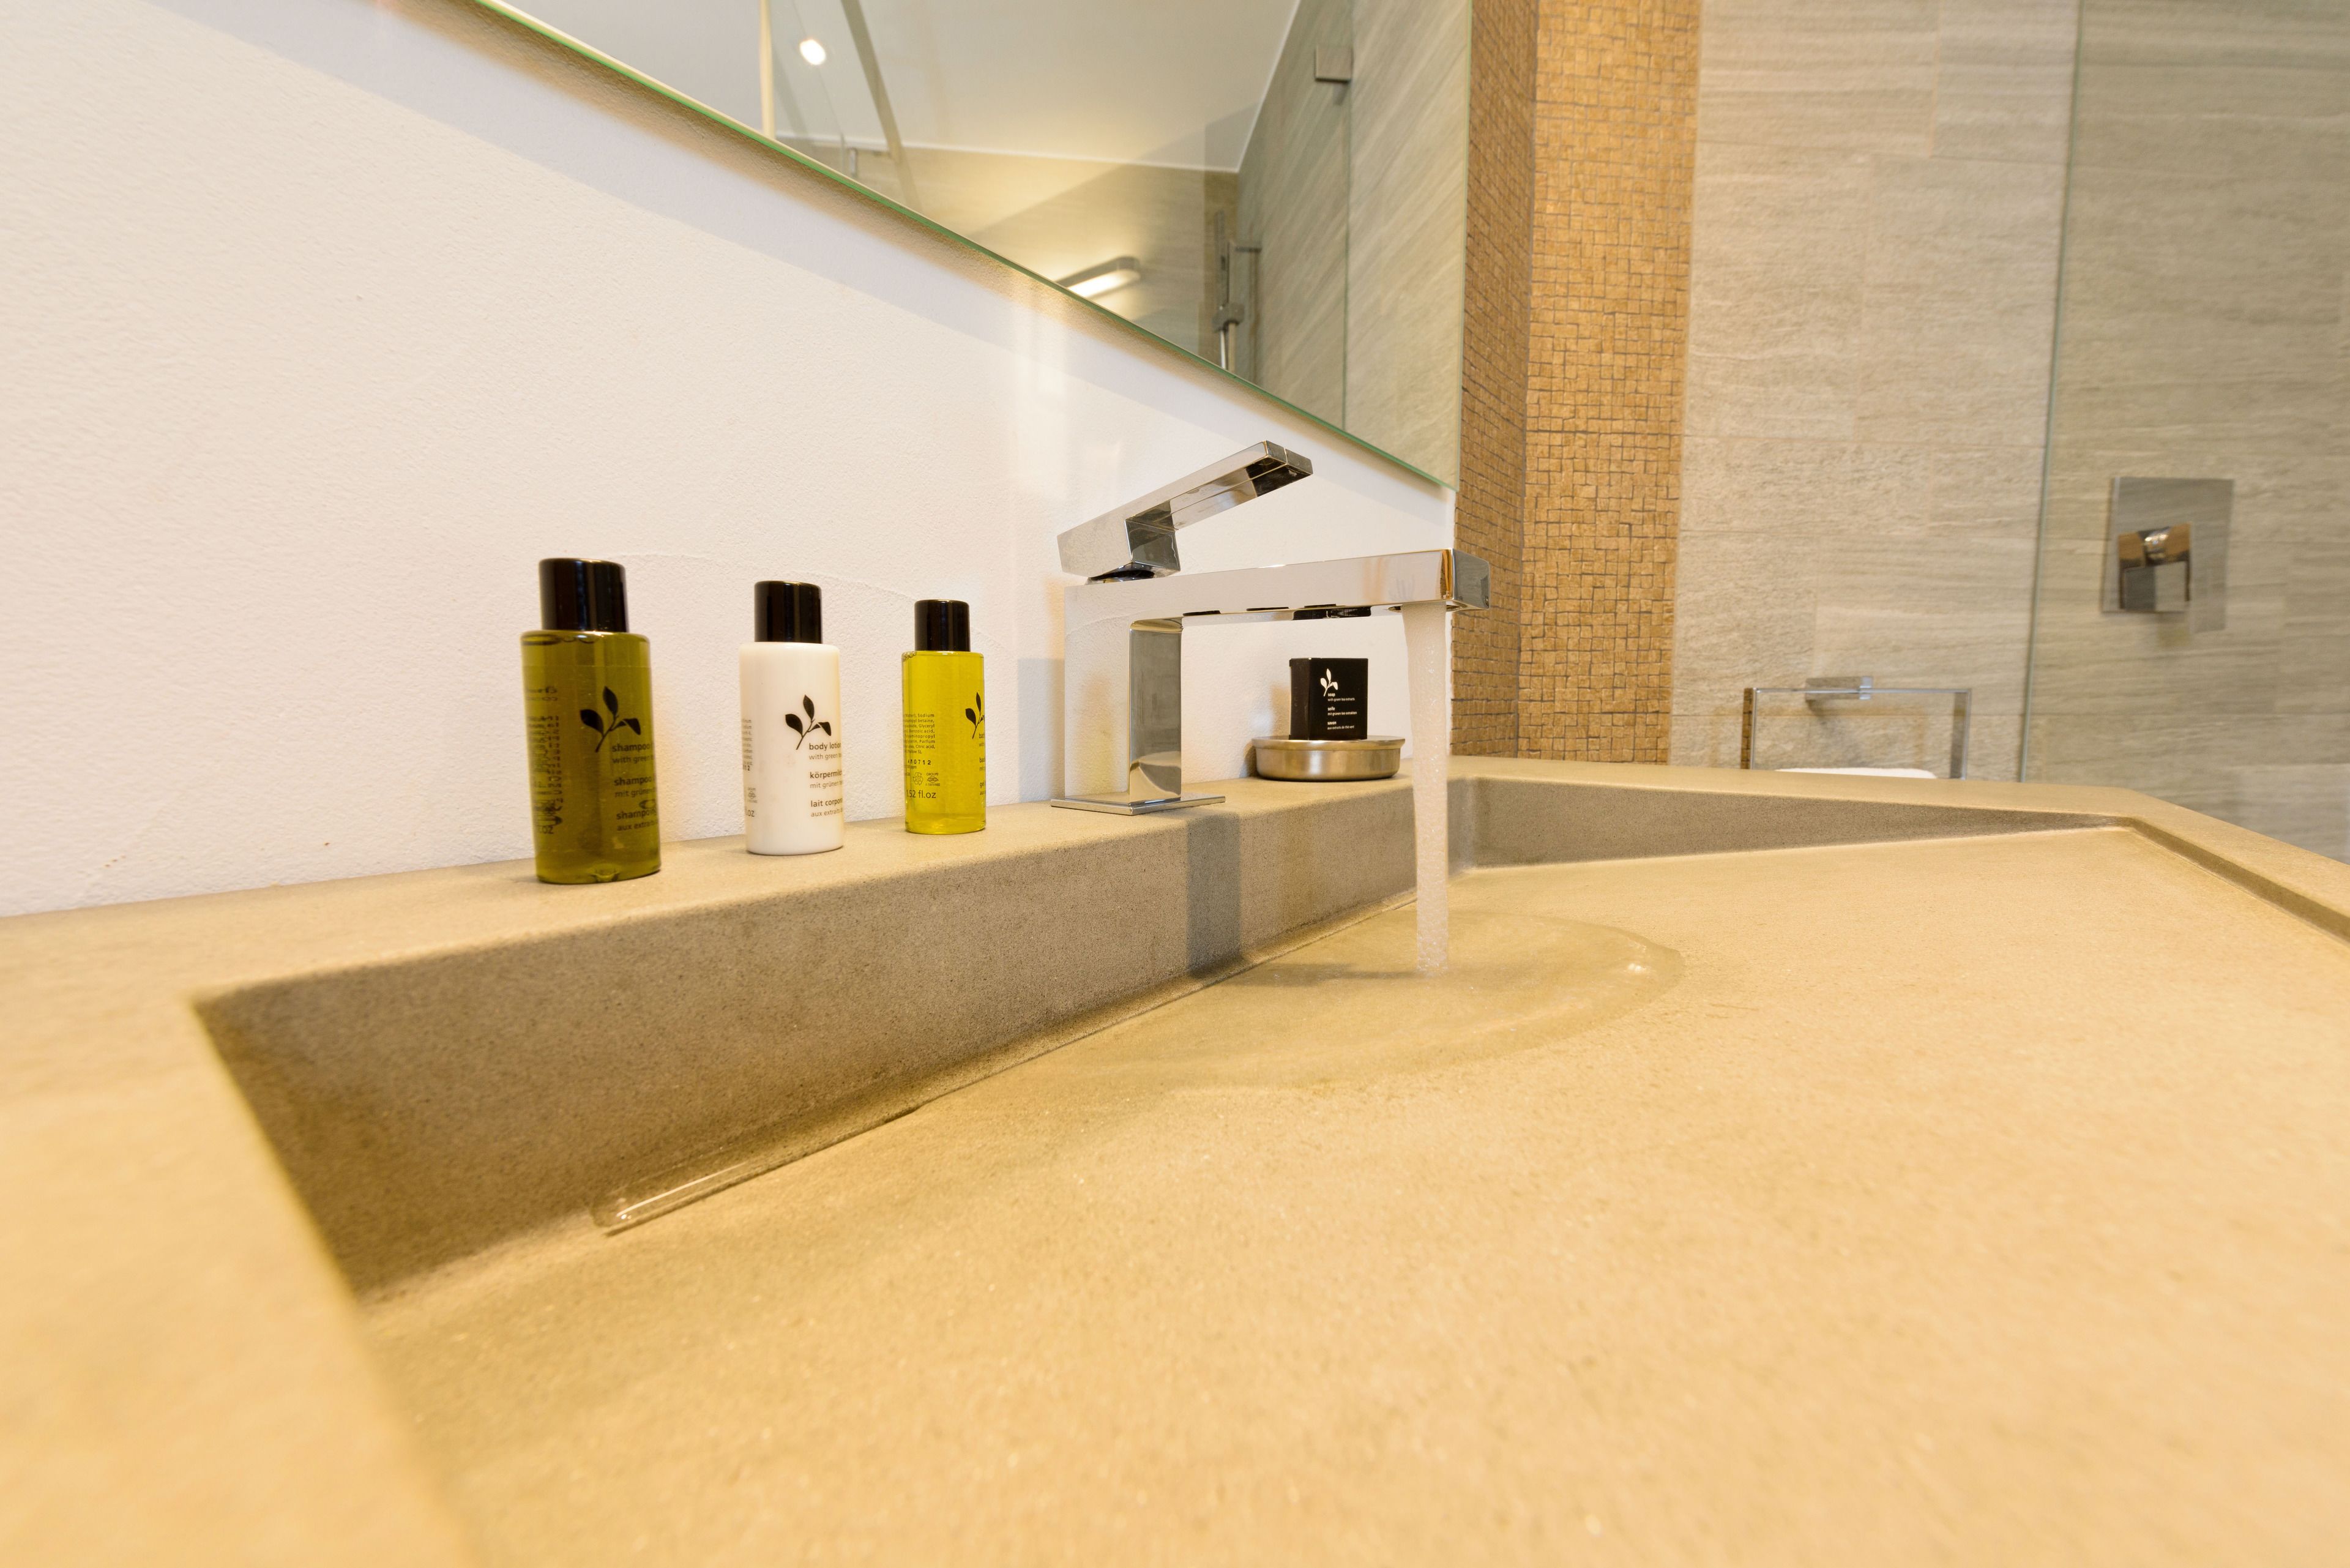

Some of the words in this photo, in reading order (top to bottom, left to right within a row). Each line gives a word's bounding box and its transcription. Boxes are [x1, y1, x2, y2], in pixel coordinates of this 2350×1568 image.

[612, 743, 650, 753] shampoo
[808, 742, 828, 751] body
[918, 790, 937, 799] fl.oz
